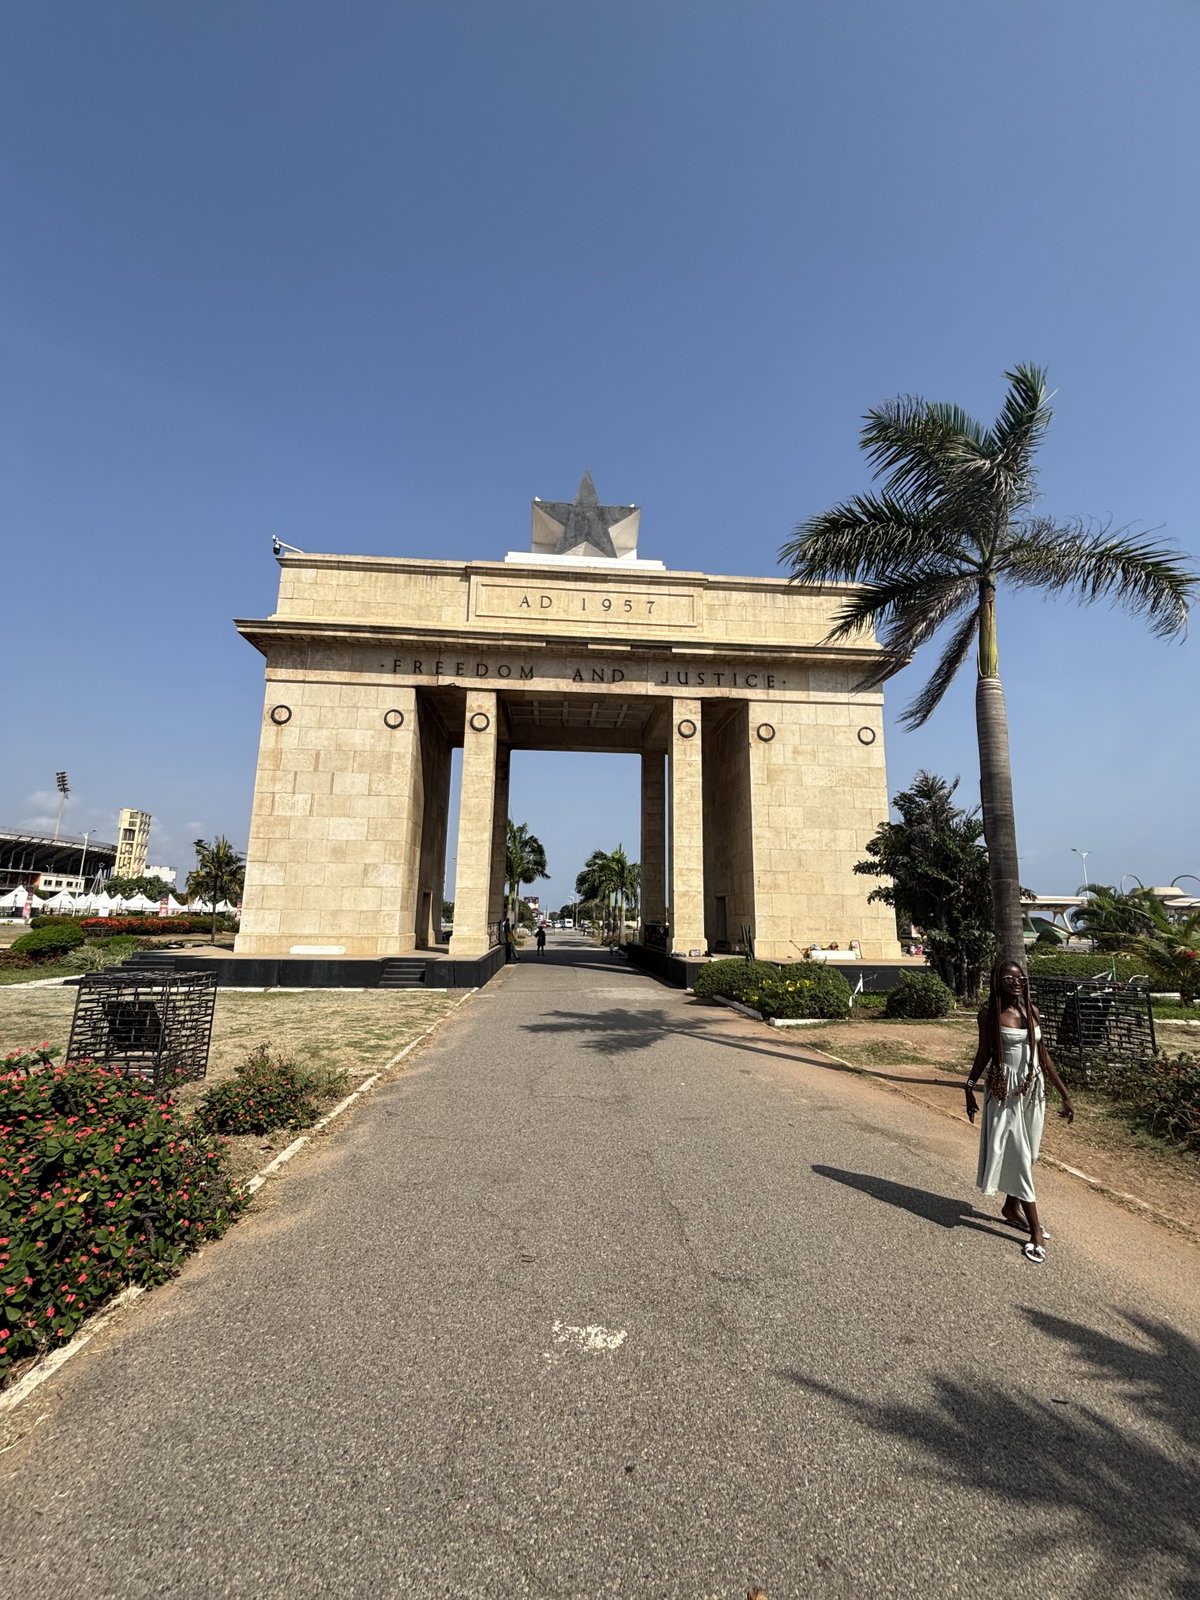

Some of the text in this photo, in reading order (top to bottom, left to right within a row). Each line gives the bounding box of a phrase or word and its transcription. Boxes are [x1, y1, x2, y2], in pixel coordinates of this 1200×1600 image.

[519, 594, 656, 614] AD 1957
[392, 659, 777, 688] FREEDOM AND JUSTICE
